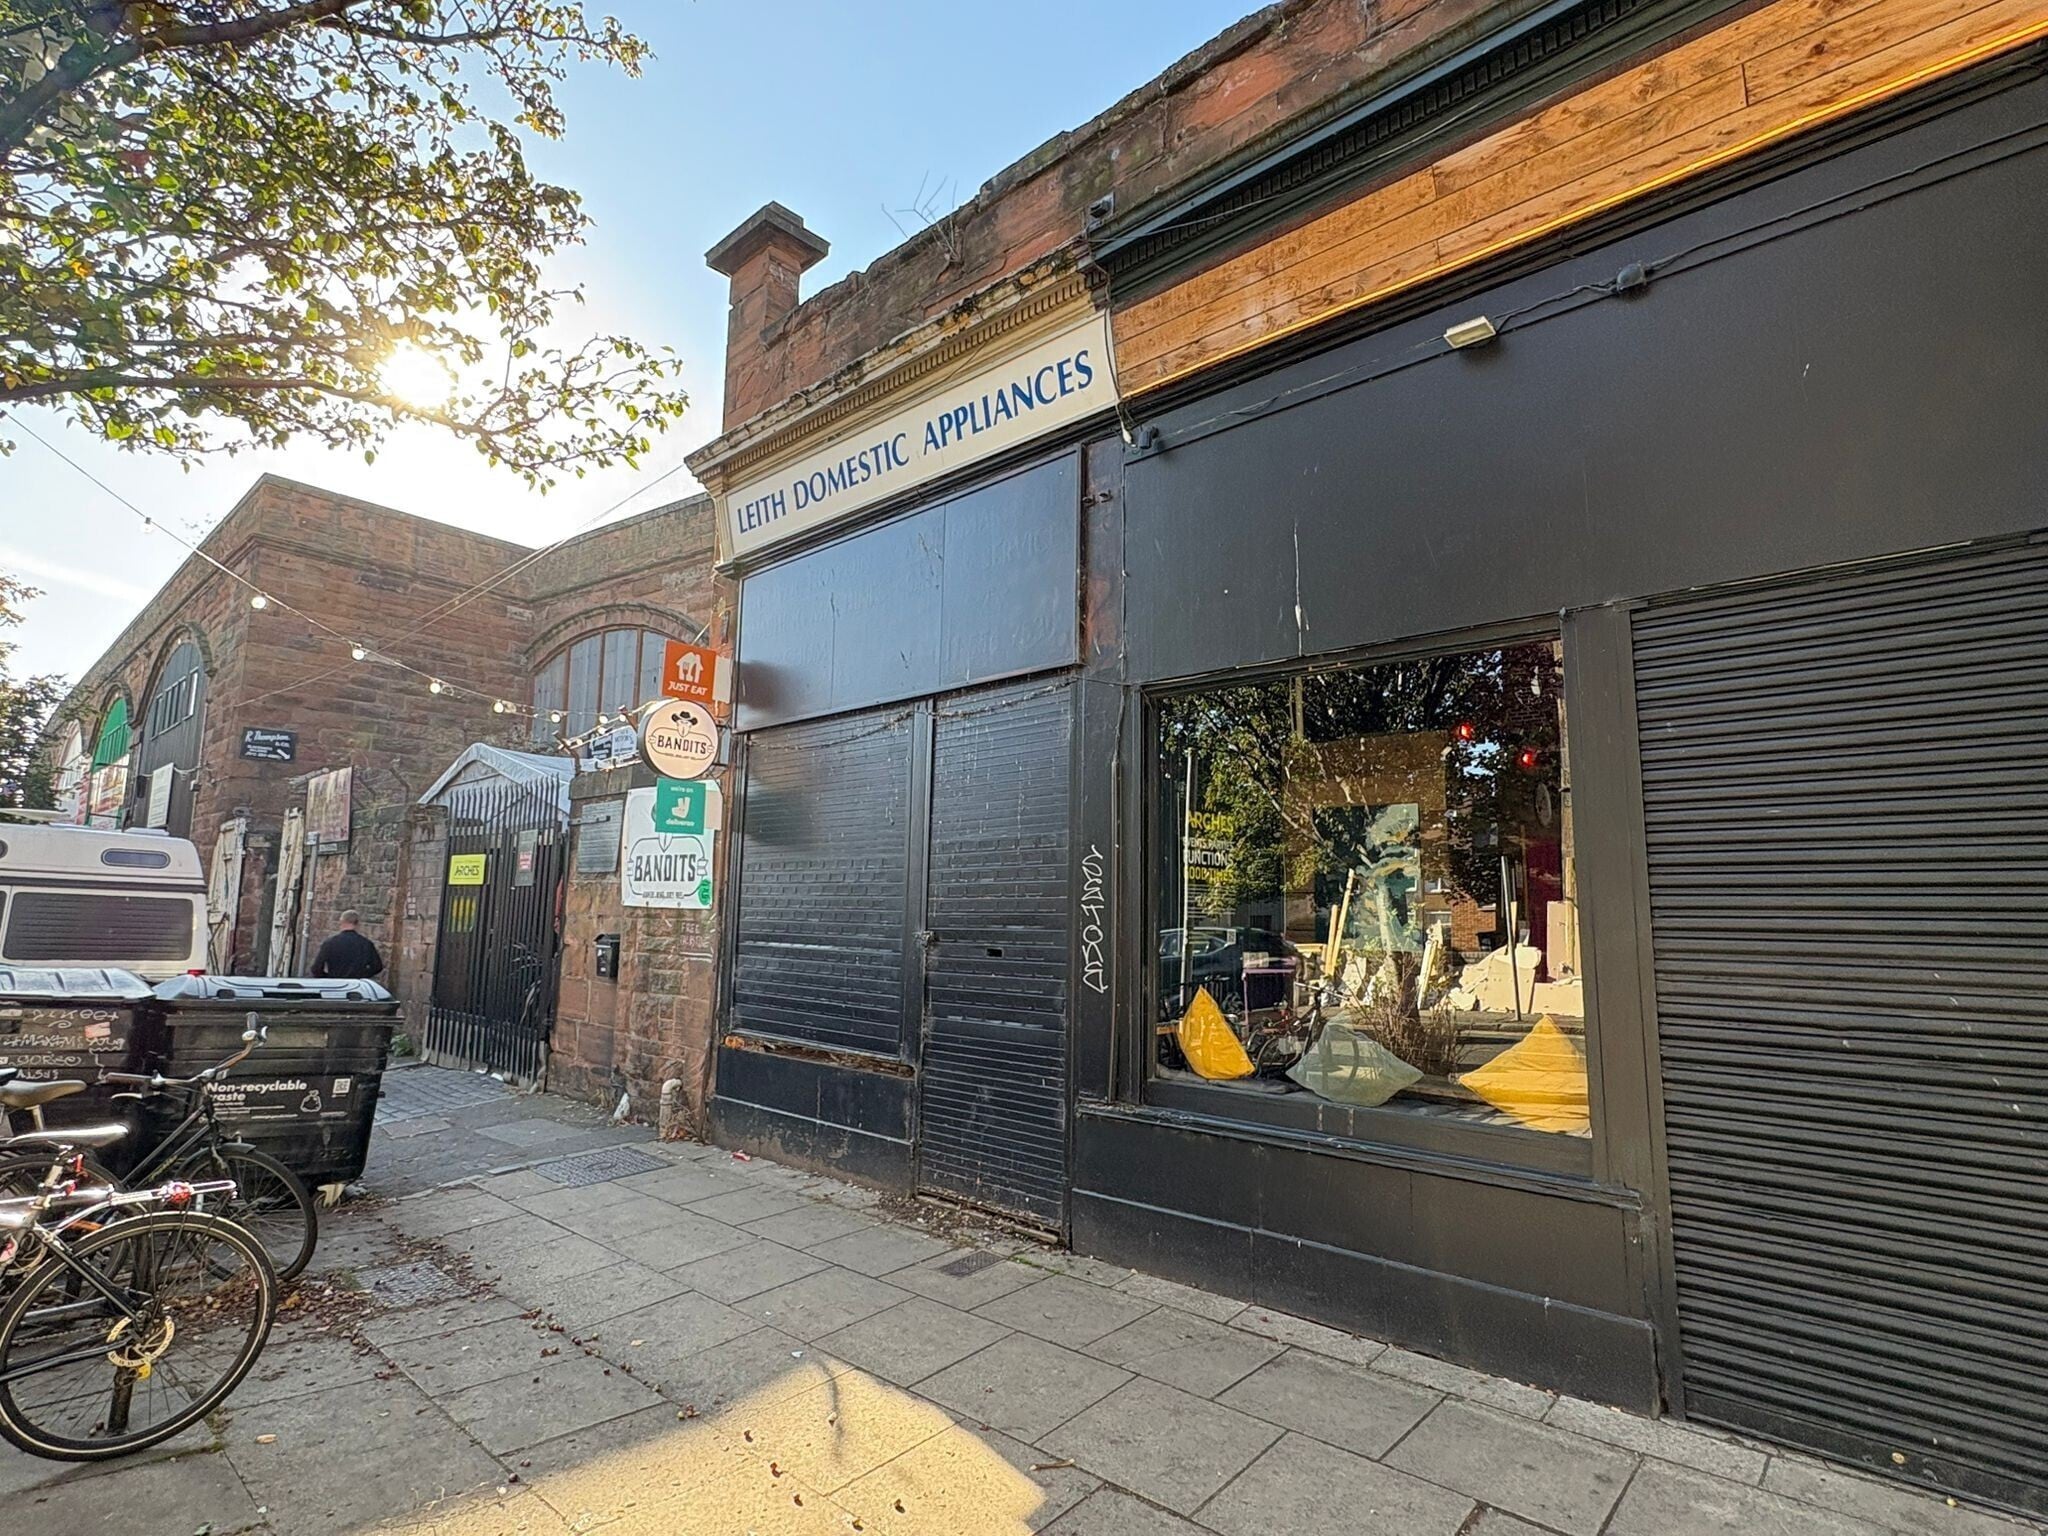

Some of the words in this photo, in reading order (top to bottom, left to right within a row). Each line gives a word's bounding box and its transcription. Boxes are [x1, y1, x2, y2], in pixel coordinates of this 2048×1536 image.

[737, 489, 786, 534] LEITH
[793, 433, 910, 511] DOMESTIC
[923, 349, 1093, 455] APPLIANCES
[667, 681, 690, 692] JUST
[690, 685, 708, 696] EAT
[657, 735, 707, 755] BANDITS
[633, 854, 697, 882] BANDITS
[206, 1080, 308, 1094] Non-recyclable
